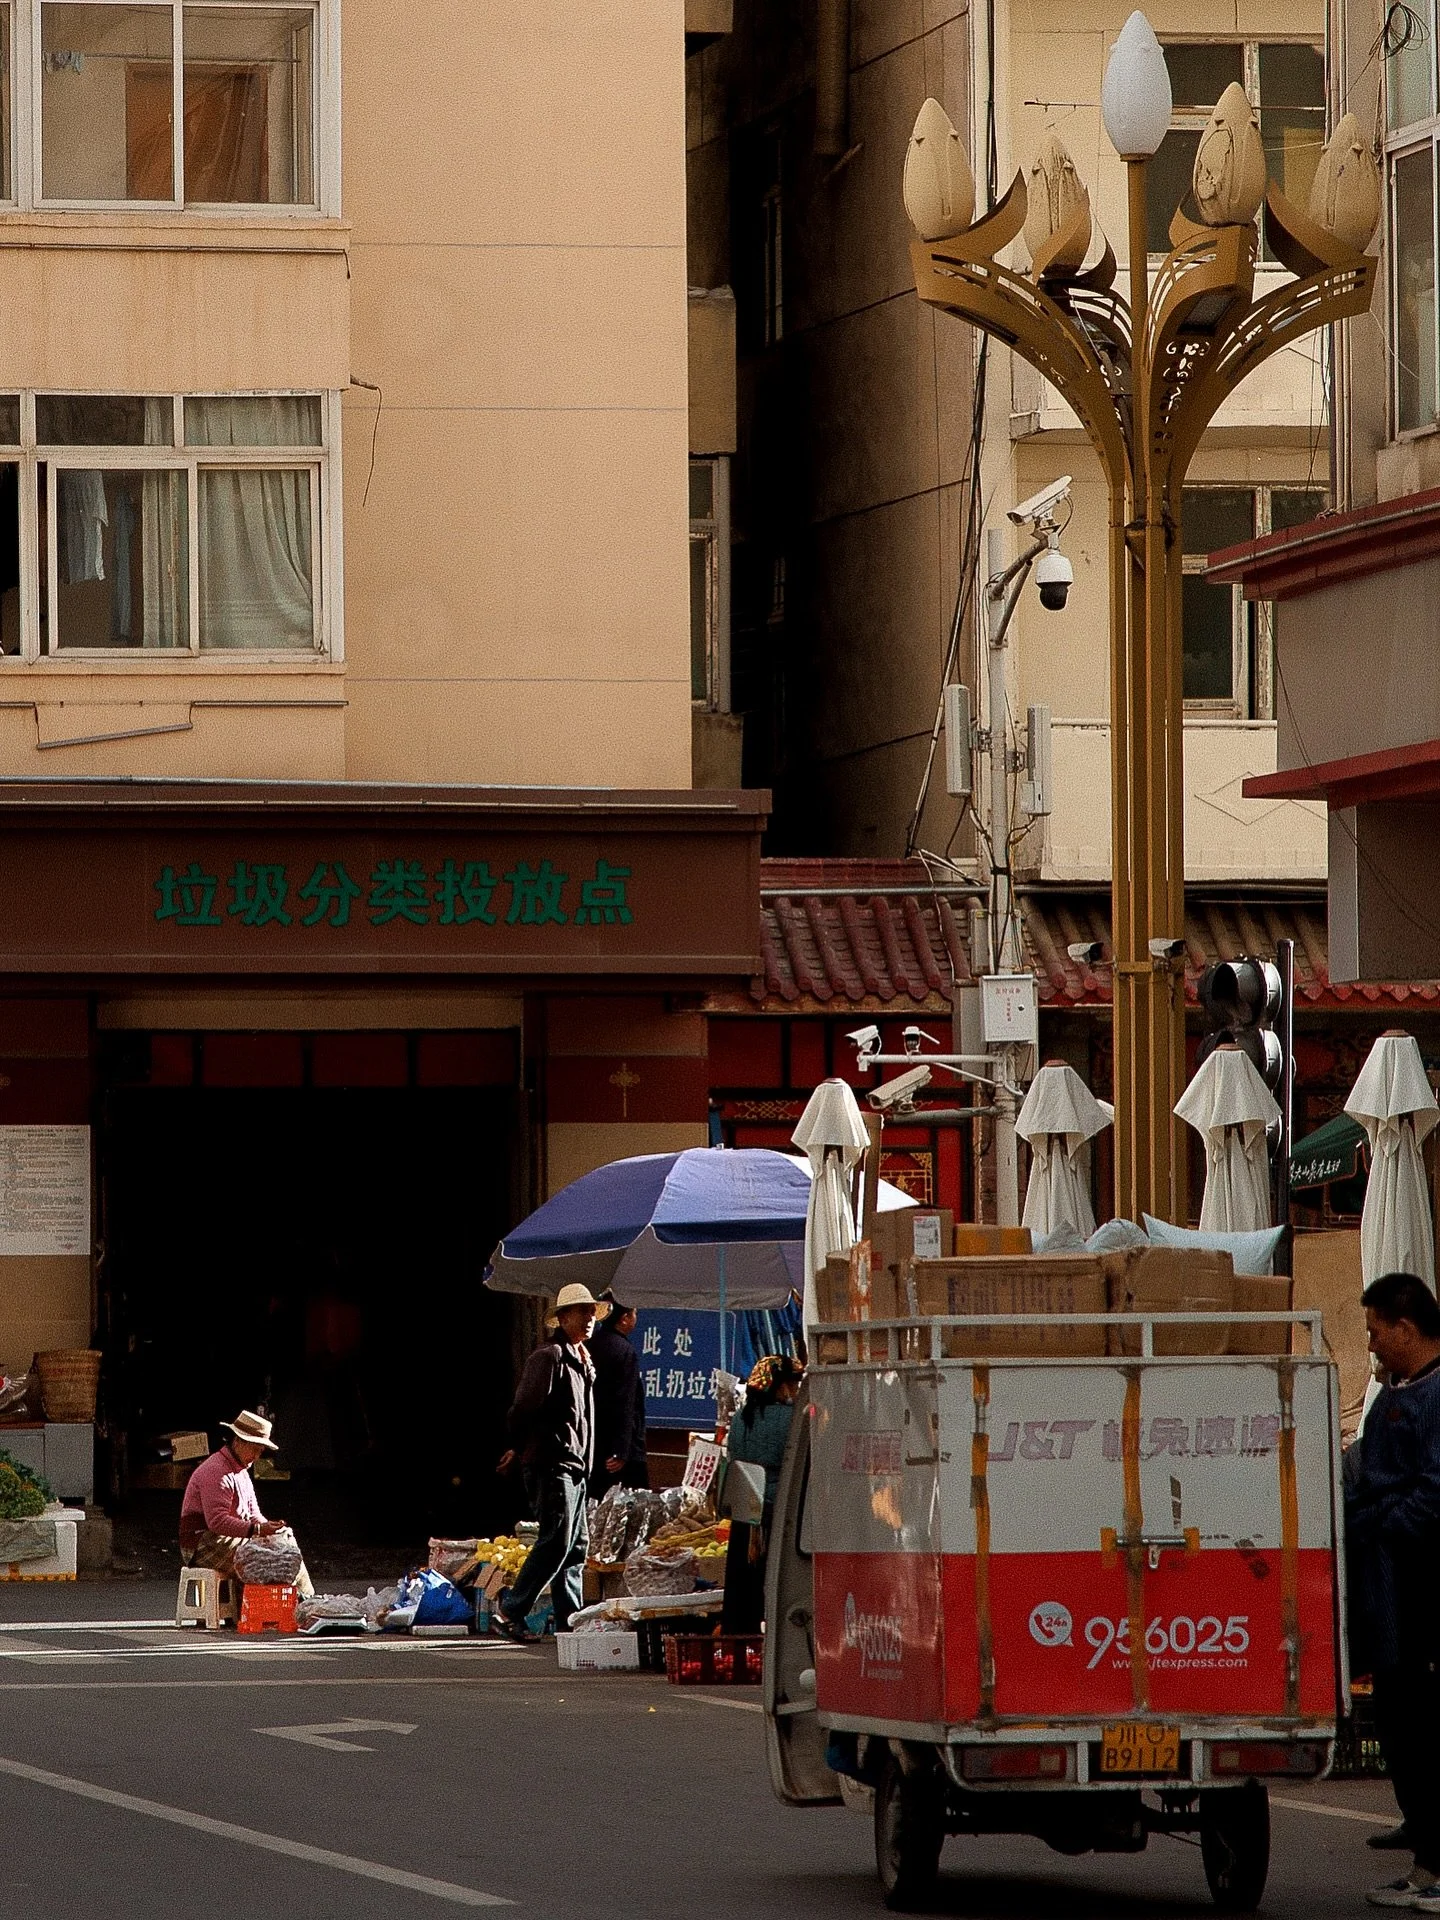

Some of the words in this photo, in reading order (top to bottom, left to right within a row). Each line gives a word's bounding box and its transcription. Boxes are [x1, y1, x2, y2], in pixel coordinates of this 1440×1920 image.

[154, 858, 635, 927] 垃圾分类投放点
[642, 1326, 693, 1357] 此处
[987, 1419, 1097, 1462] J&T
[1084, 1615, 1250, 1670] 956025
[1112, 1656, 1249, 1671] ww.jtexpress.com
[1105, 1746, 1176, 1769] B9112
